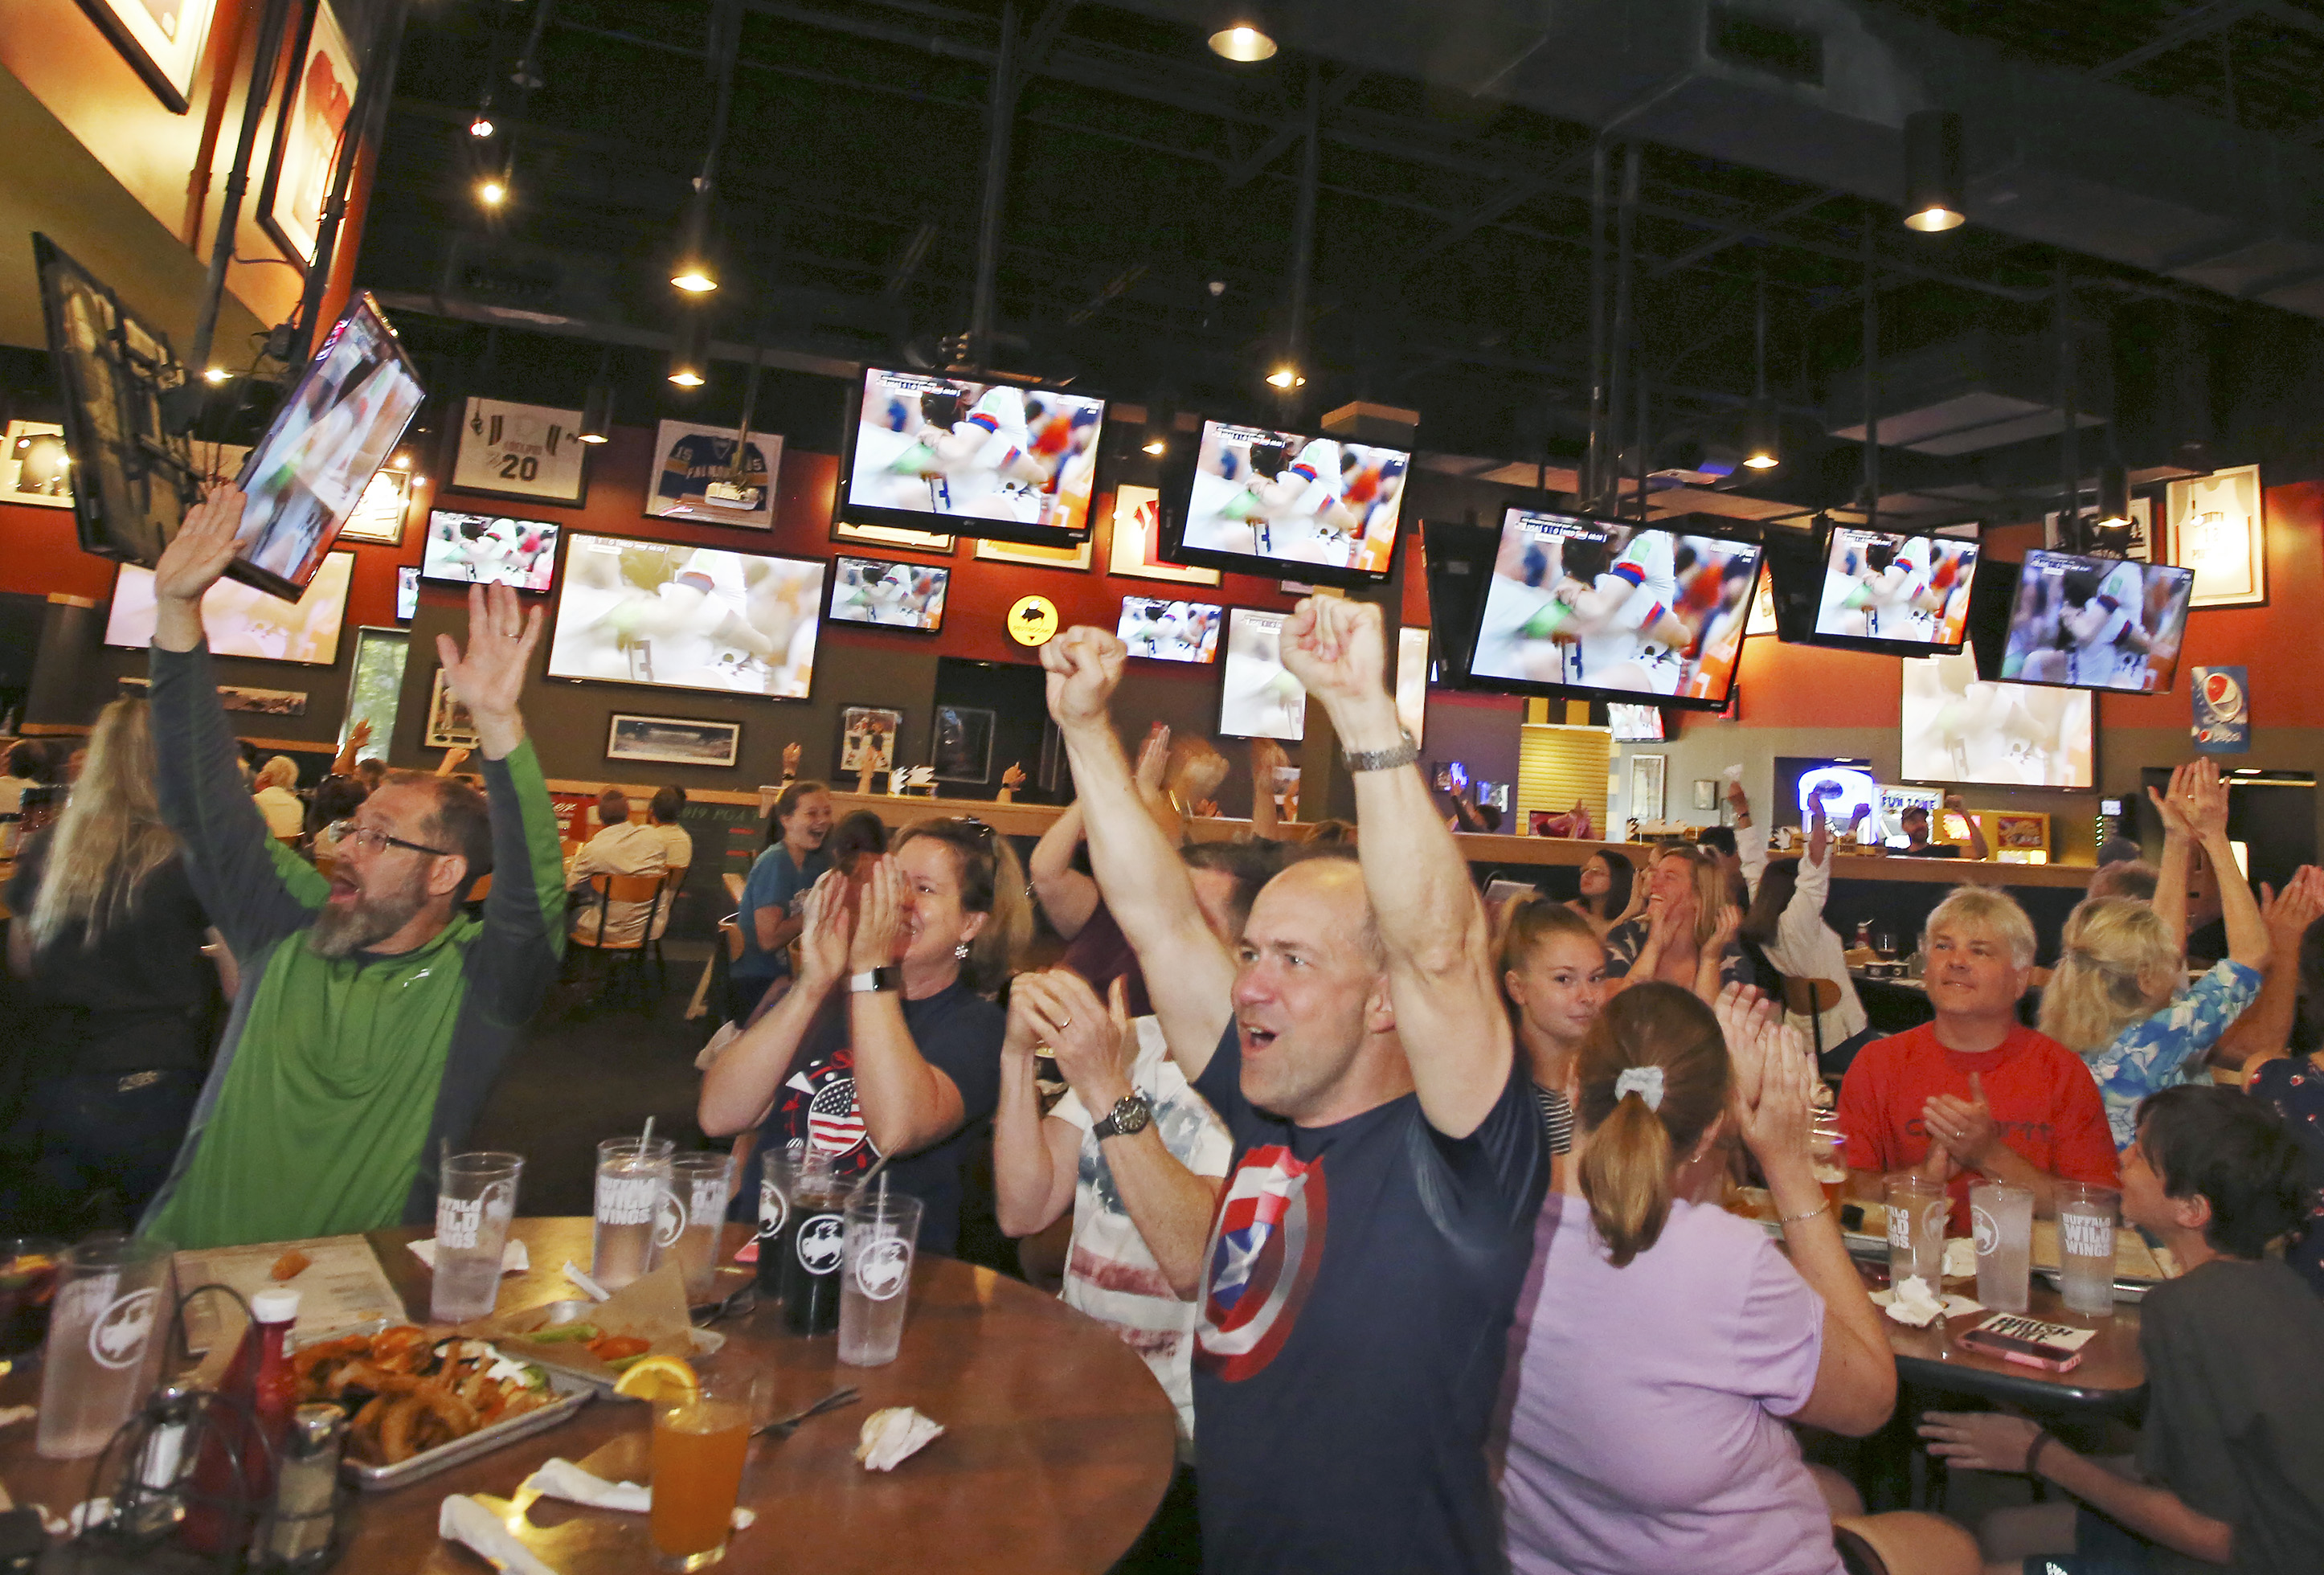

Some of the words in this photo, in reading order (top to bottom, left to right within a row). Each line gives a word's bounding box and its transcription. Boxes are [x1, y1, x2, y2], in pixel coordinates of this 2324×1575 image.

[499, 454, 538, 481] 20
[1881, 796, 1904, 808] FUN
[598, 1207, 652, 1225] WINGS
[2062, 1213, 2111, 1229] BUFFALO
[2064, 1223, 2111, 1246] WILD
[2065, 1238, 2111, 1258] WINGS
